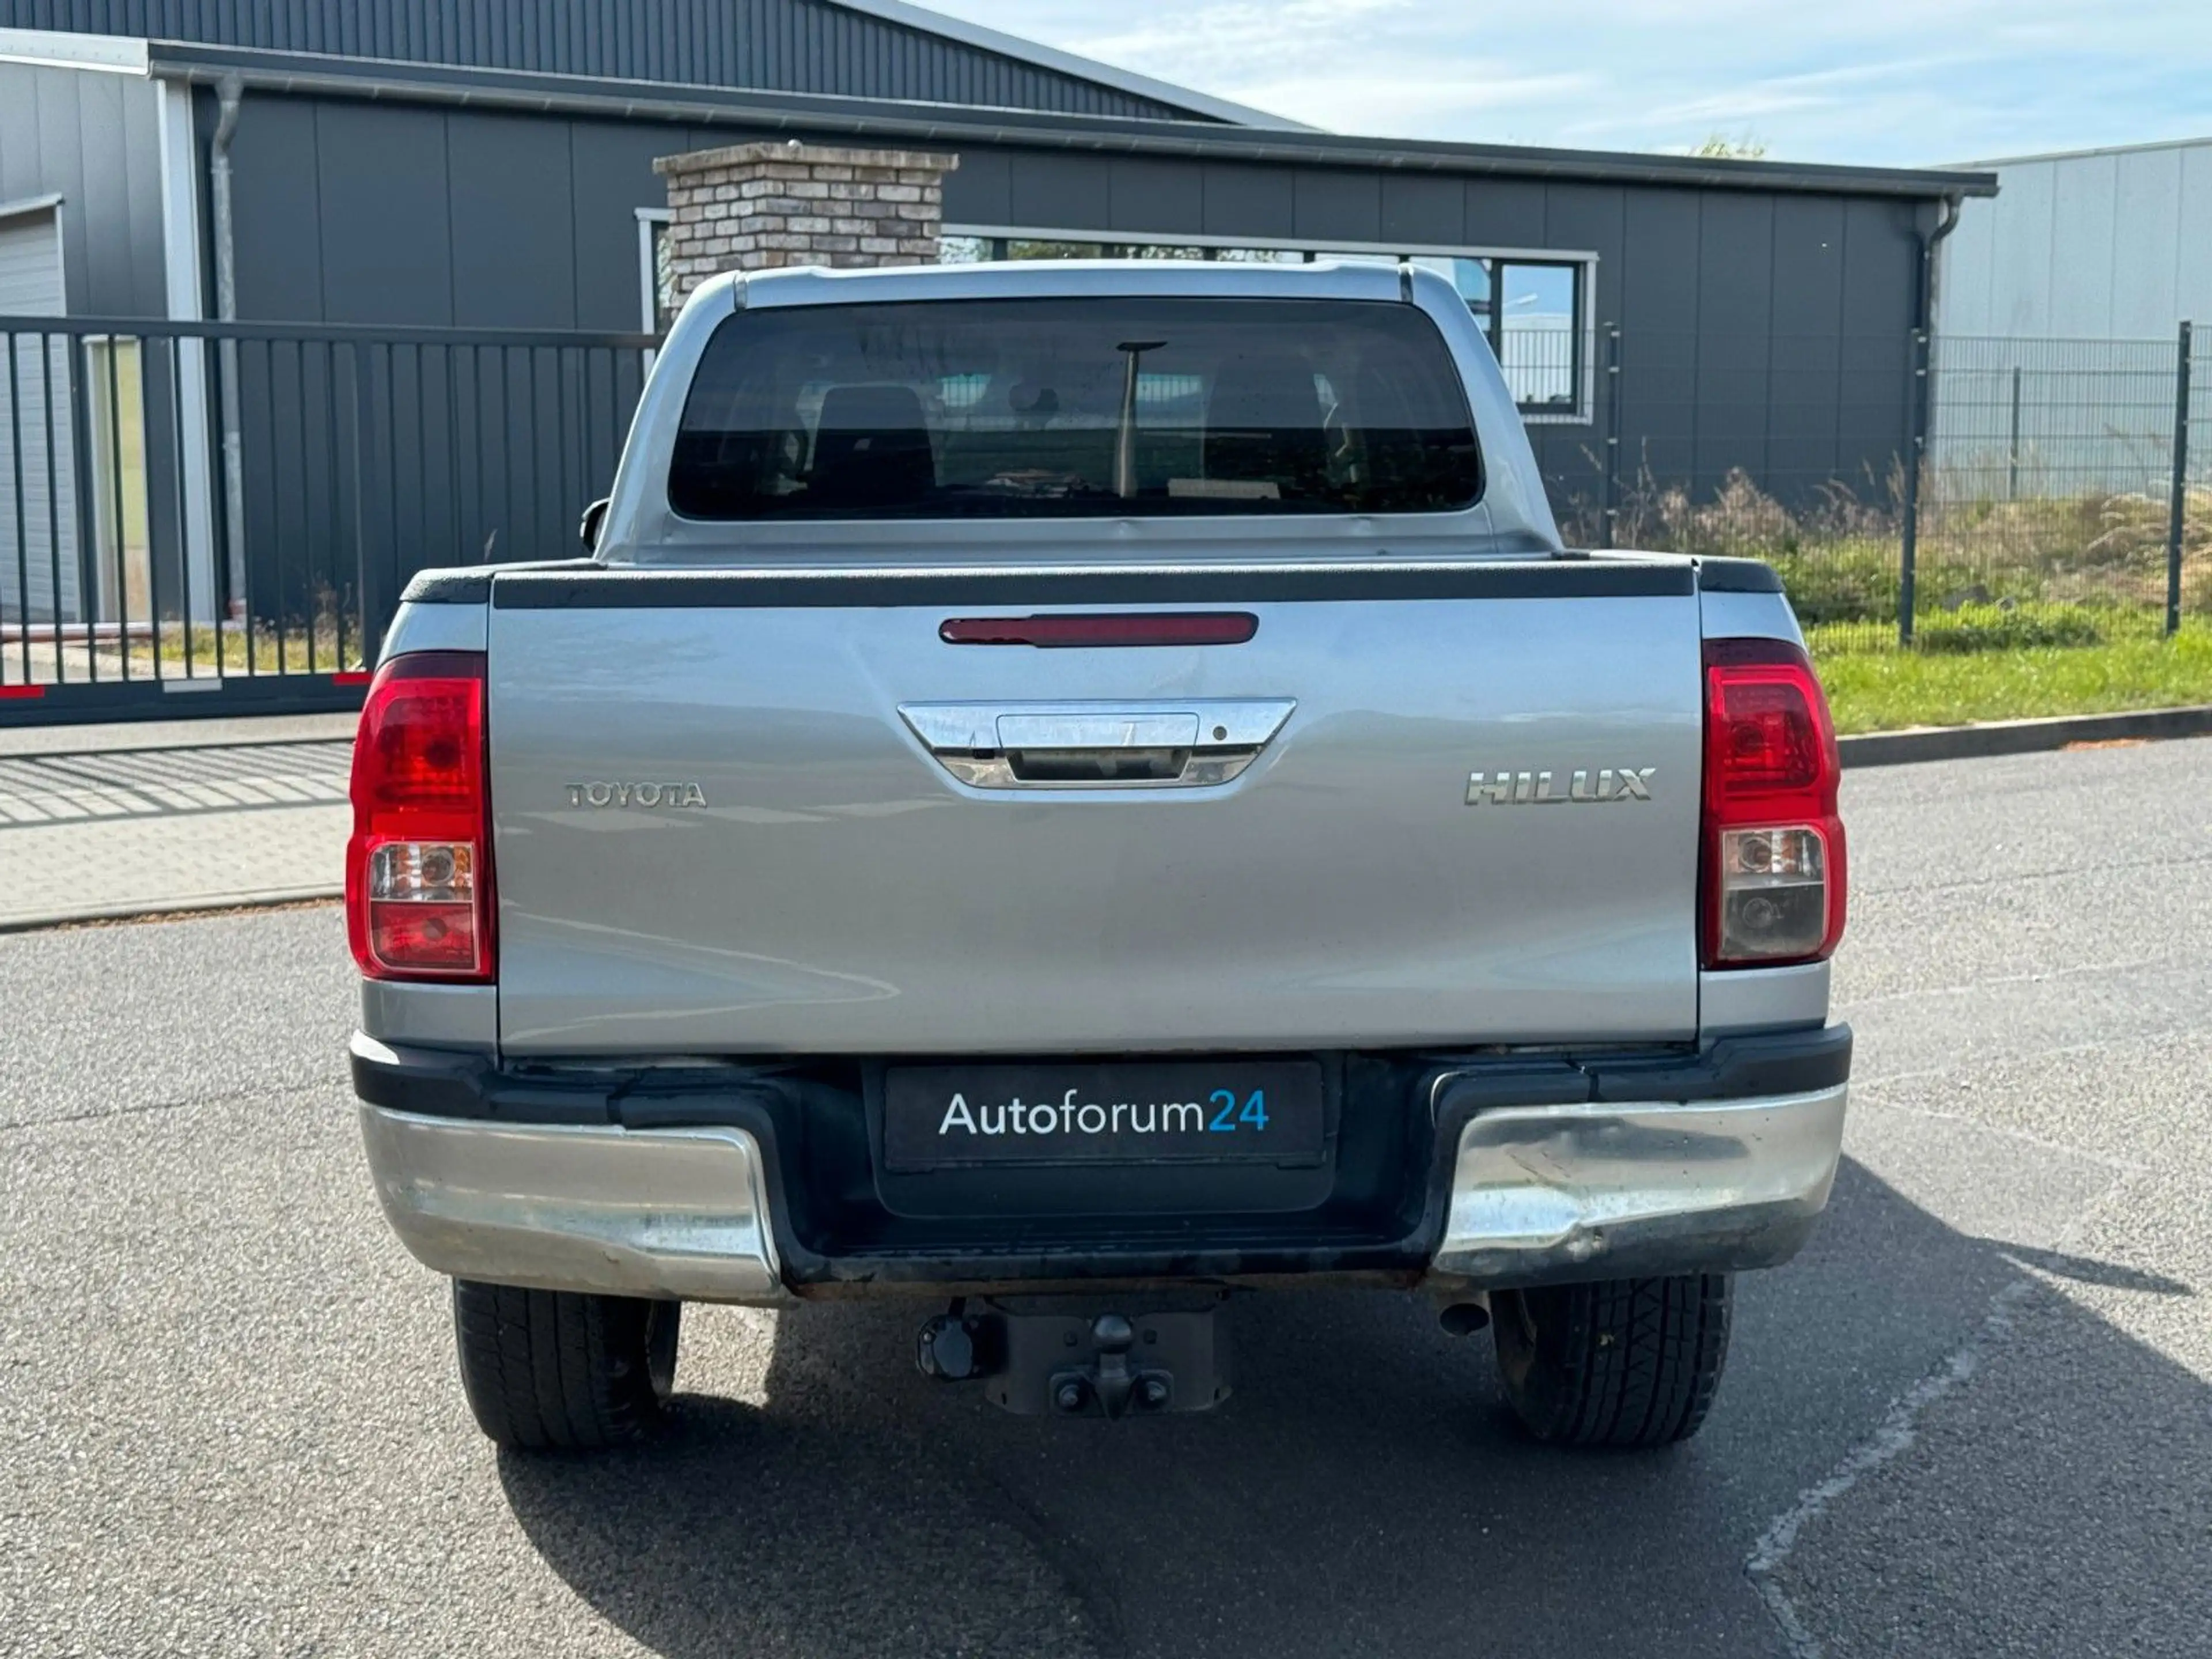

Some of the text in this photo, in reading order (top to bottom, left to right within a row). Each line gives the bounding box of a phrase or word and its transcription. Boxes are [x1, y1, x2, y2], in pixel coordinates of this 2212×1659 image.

[565, 782, 707, 807] TOYOTA
[1465, 768, 1656, 805] HILUX
[939, 1088, 1270, 1135] Autoforum24
